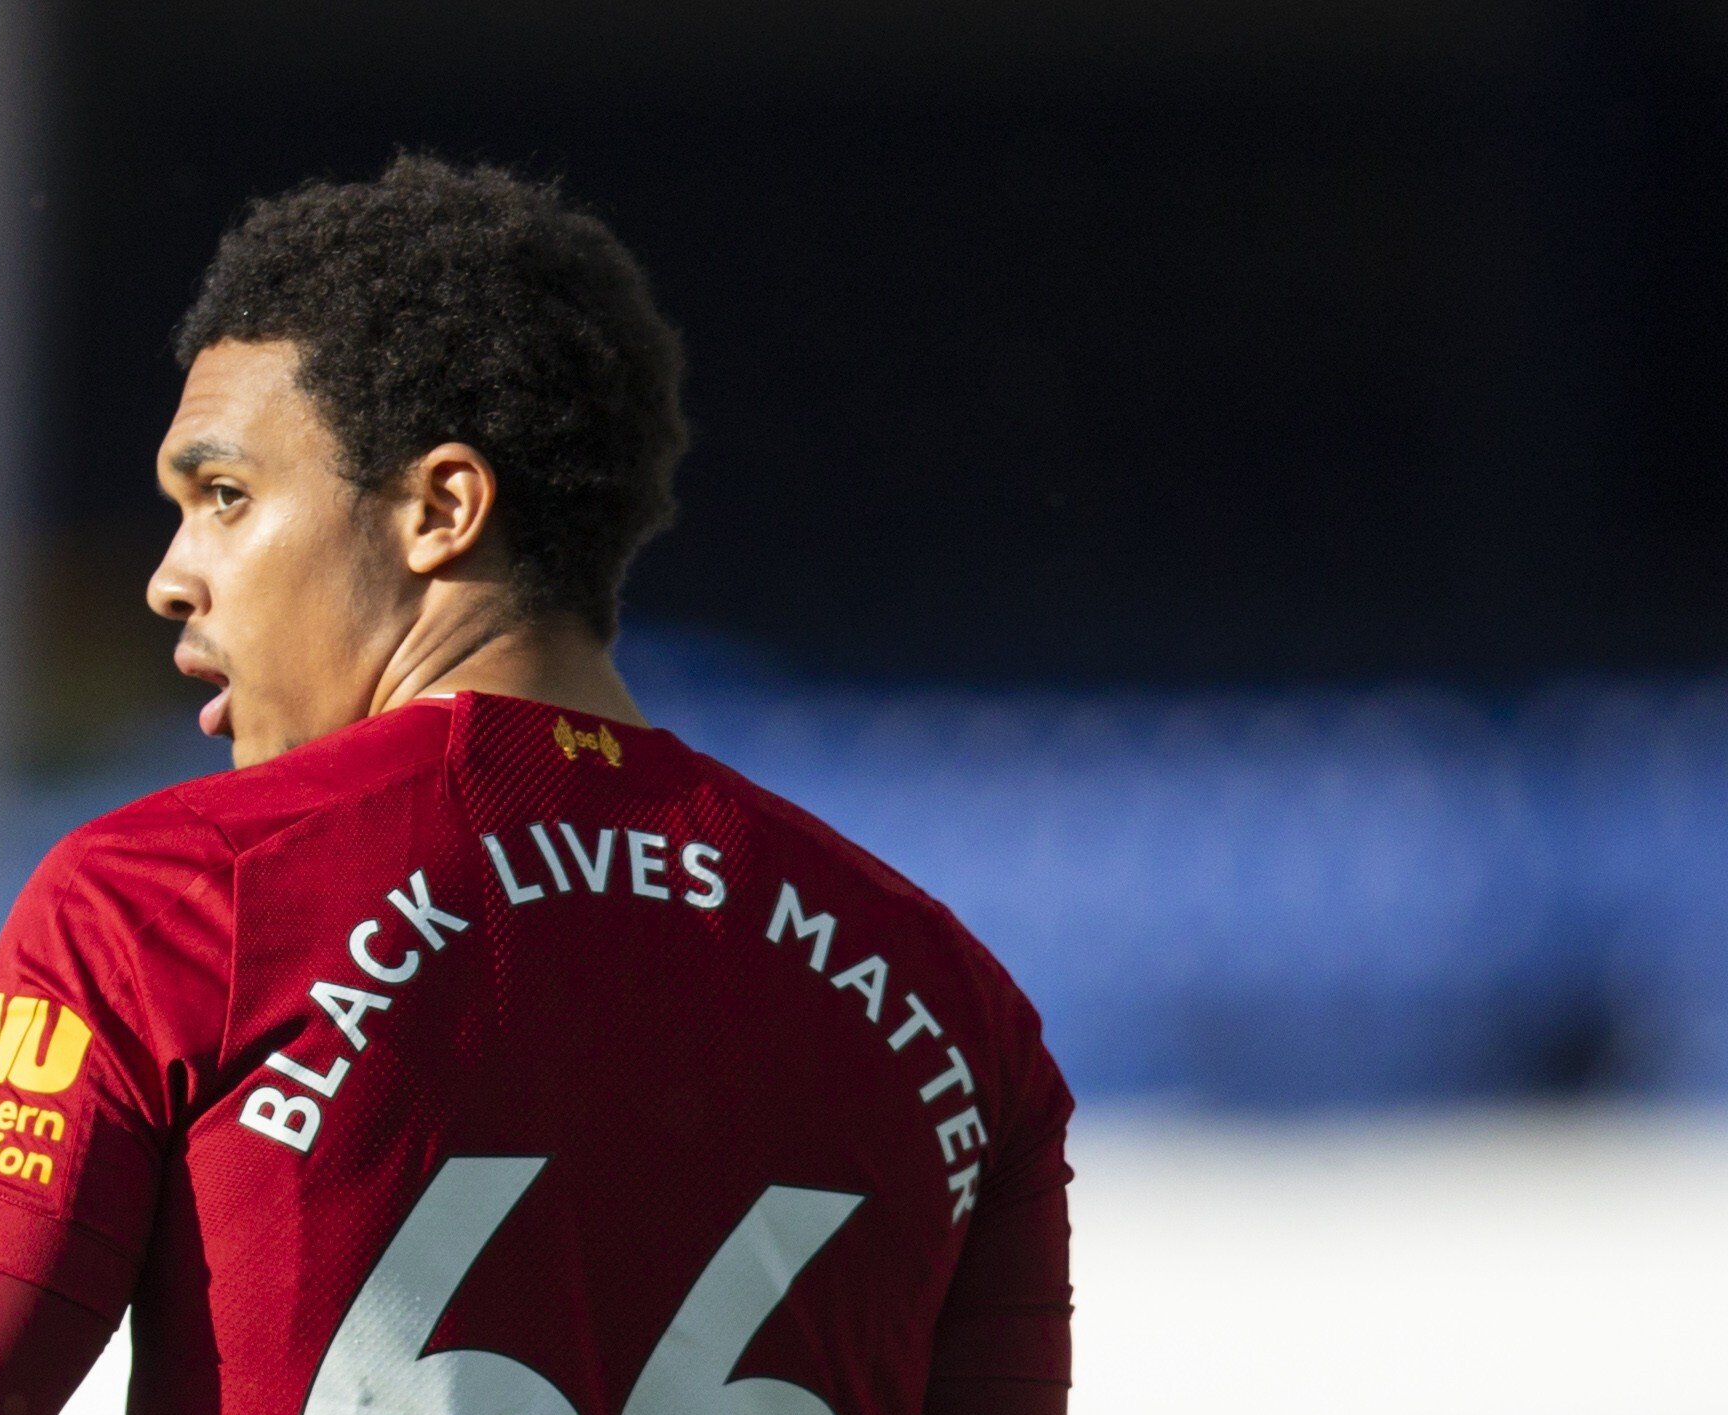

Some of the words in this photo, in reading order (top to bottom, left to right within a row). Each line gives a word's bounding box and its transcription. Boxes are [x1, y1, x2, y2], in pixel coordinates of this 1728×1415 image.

[238, 866, 470, 1154] BLACK
[481, 820, 727, 910] LIVES
[764, 882, 989, 1225] MATTER
